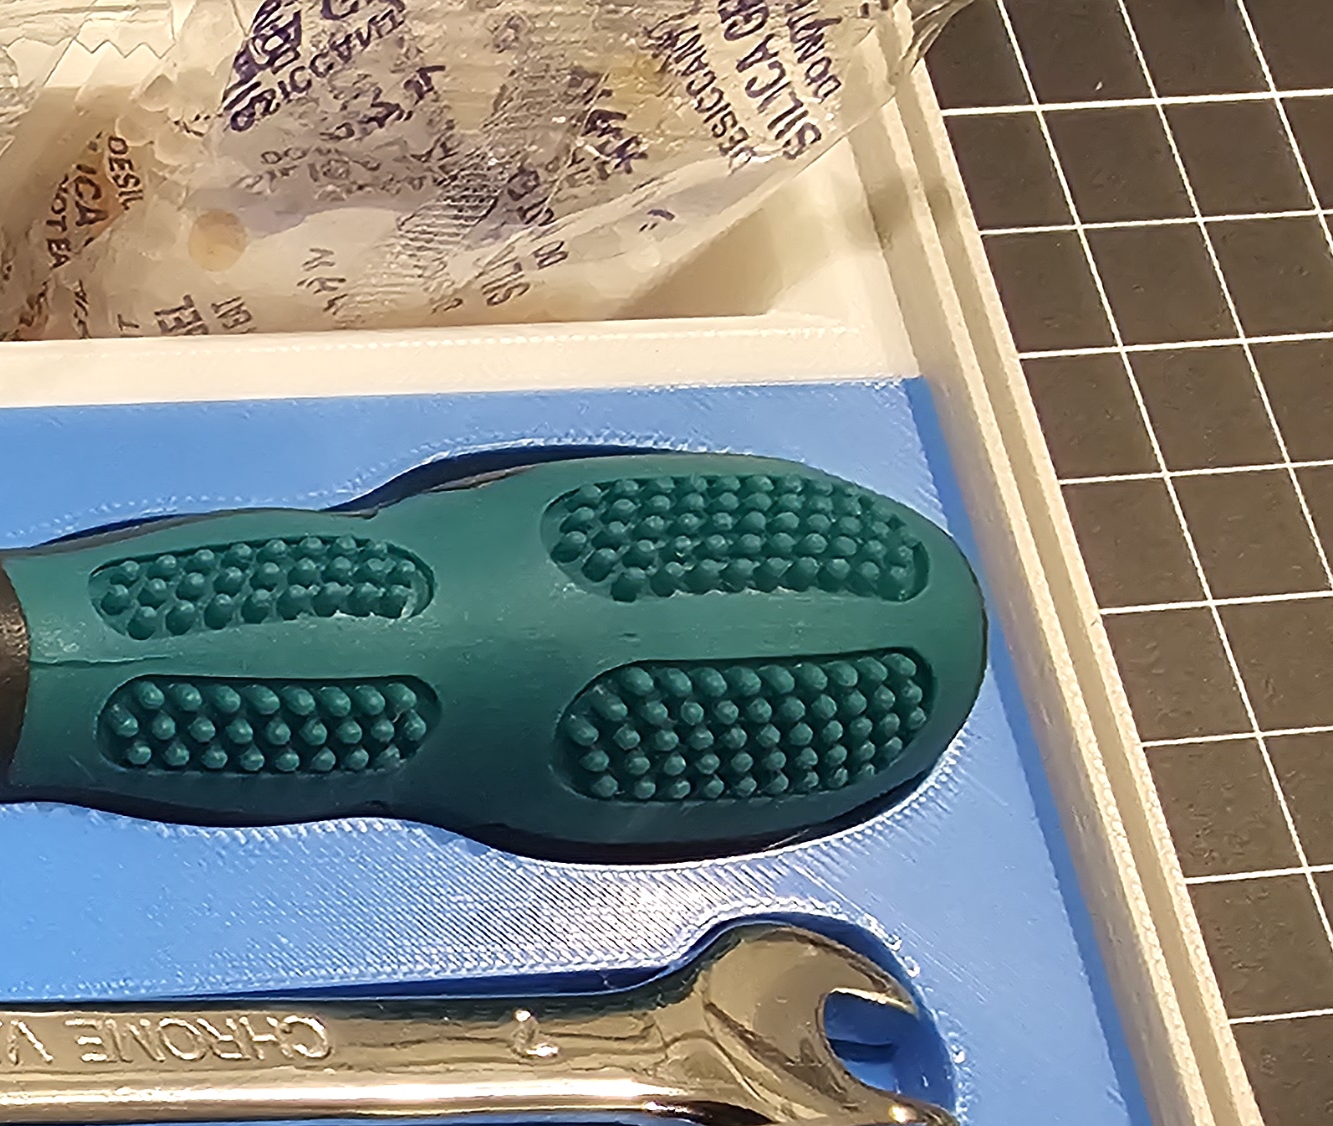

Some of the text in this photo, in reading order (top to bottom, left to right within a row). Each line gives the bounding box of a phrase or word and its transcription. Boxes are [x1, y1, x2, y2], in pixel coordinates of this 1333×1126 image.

[736, 33, 822, 160] SILICA
[805, 56, 842, 103] DO
[66, 1014, 334, 1063] CHROME
